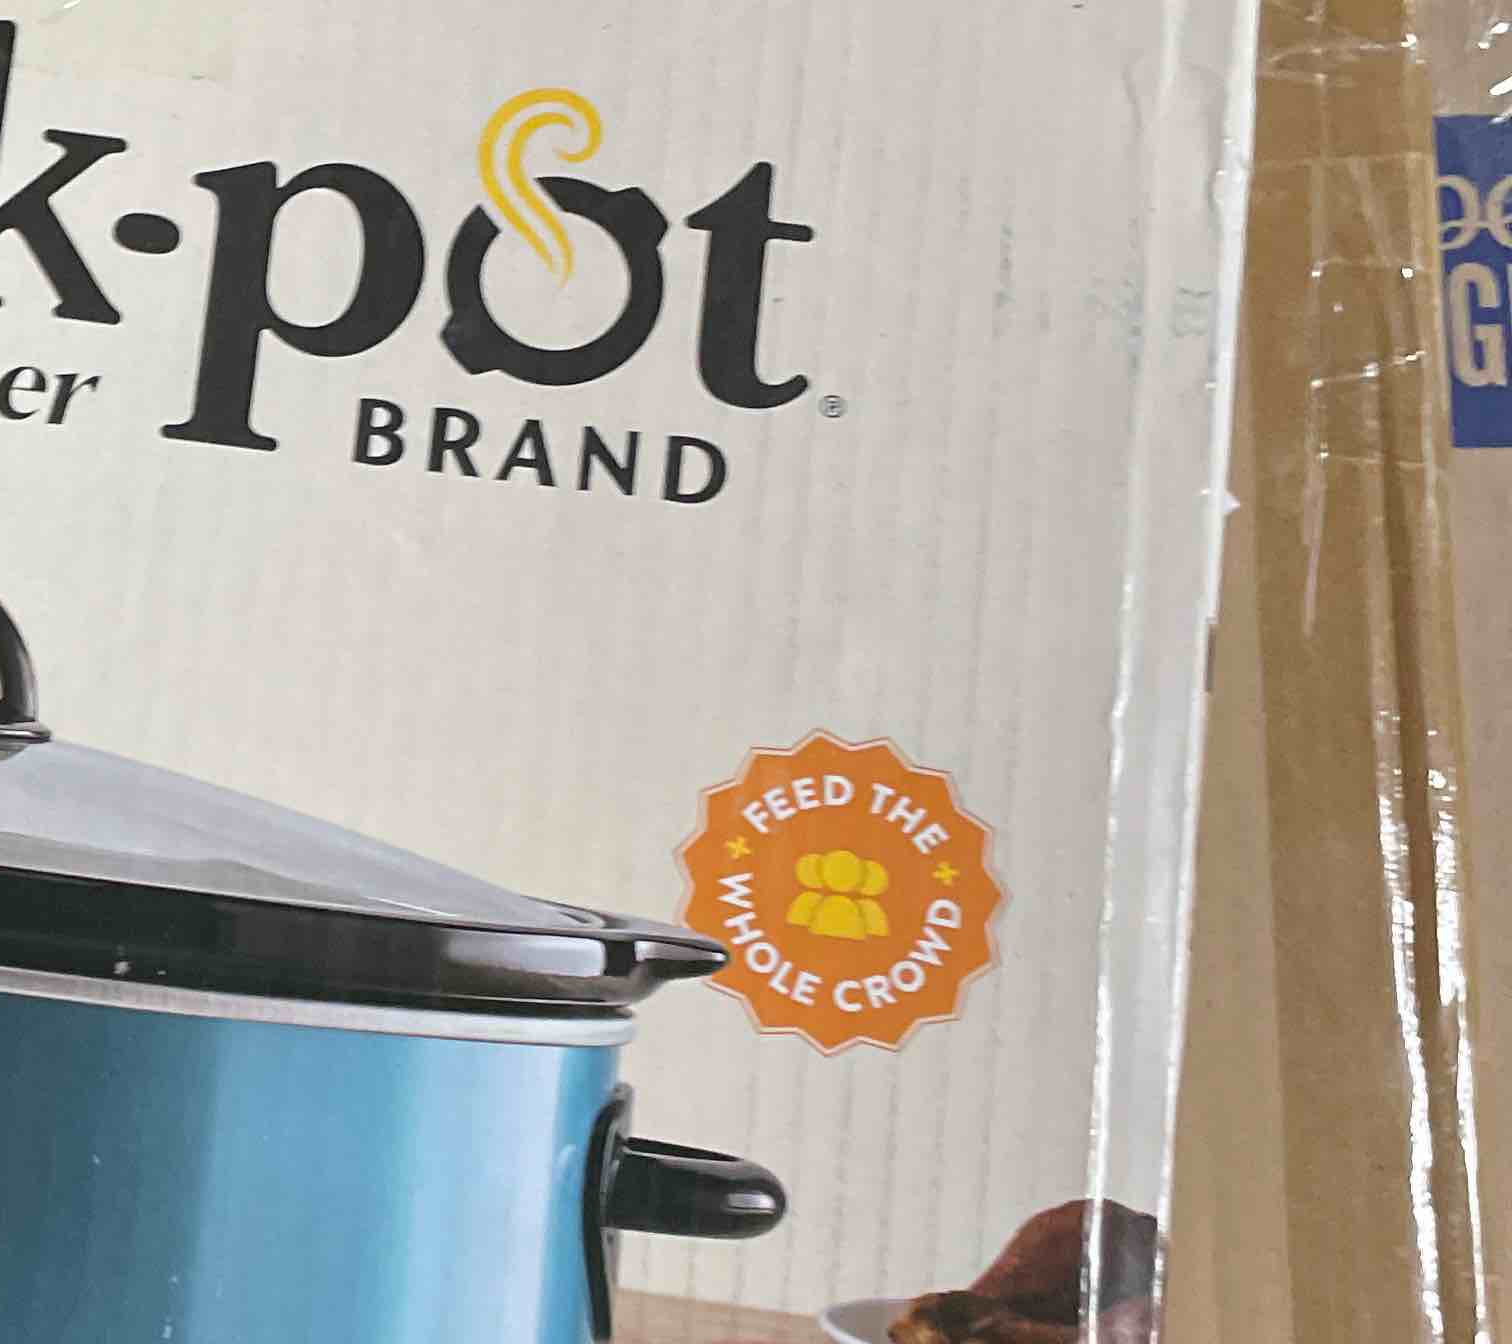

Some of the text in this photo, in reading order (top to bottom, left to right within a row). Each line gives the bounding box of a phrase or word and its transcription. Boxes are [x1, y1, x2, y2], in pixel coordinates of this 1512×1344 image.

[1449, 262, 1512, 387] G
[351, 396, 729, 506] BRAND
[741, 773, 951, 856] FEED THE
[716, 871, 963, 1014] WHOLE CROWD
